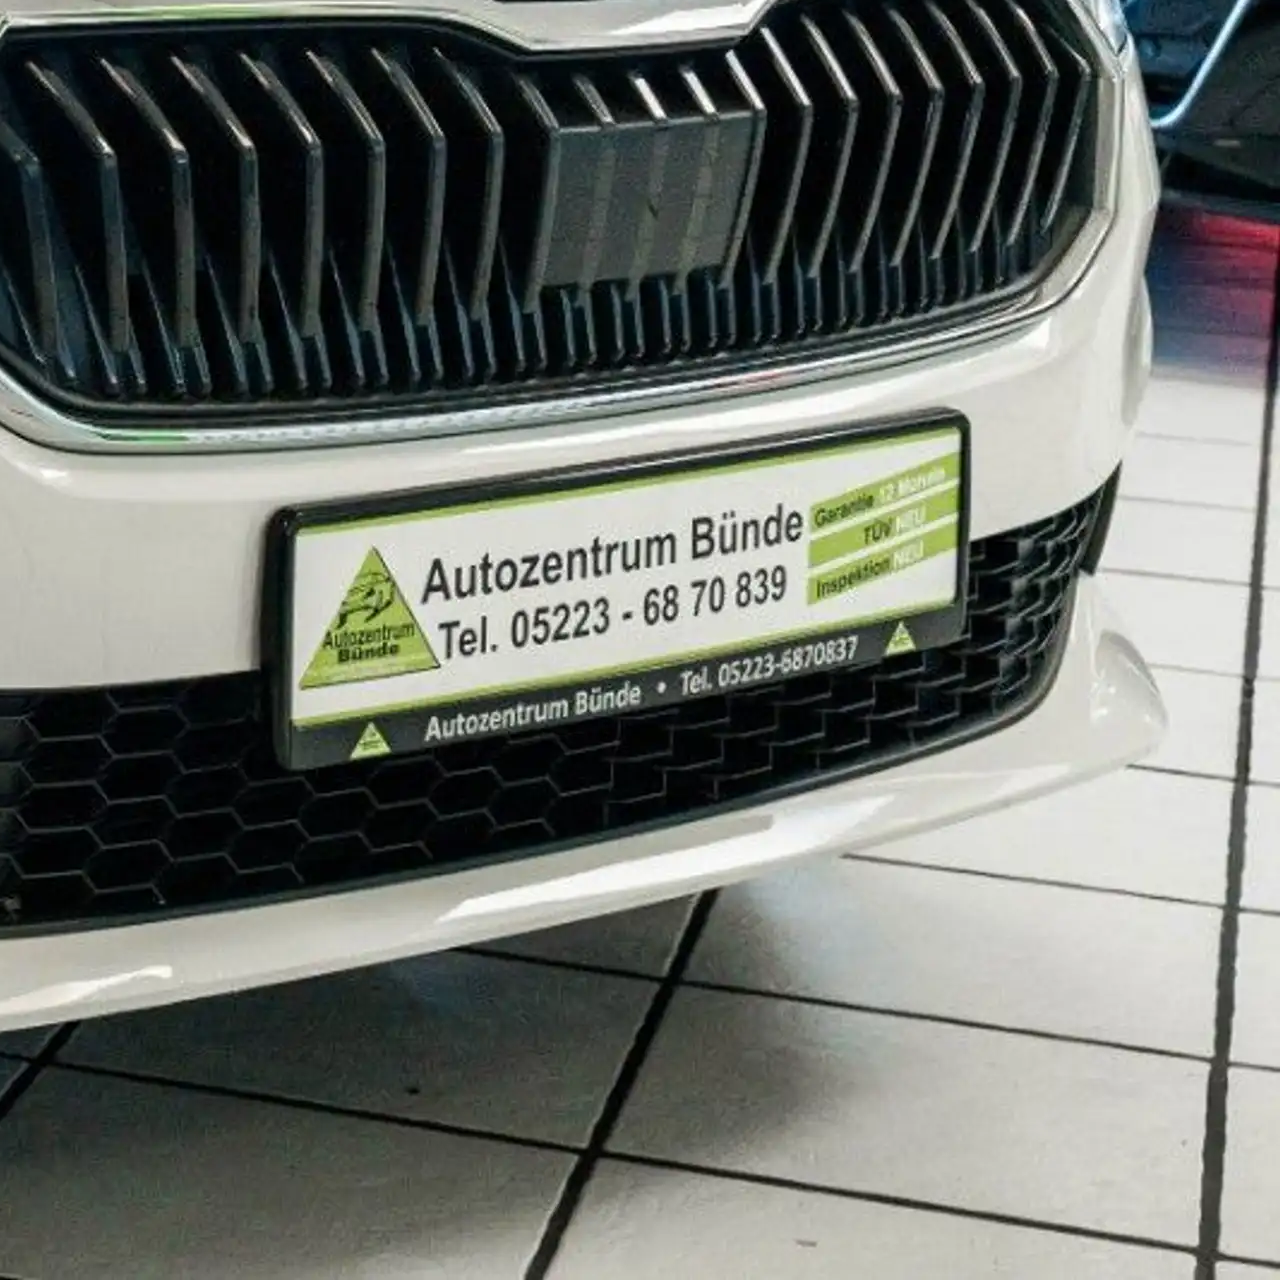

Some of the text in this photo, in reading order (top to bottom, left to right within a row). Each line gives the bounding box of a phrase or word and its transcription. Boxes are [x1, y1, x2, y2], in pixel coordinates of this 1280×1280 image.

[420, 503, 803, 605] Autozentrum Bünde
[323, 621, 416, 651] Autozentrum
[337, 643, 401, 664] Bünde
[438, 615, 498, 661] Tel.
[510, 597, 611, 648] 05223
[642, 584, 681, 627] 68
[691, 576, 727, 617] 70
[735, 564, 788, 609] 839
[424, 634, 860, 742] Autozentrum Bünde Tel. 05223-6870837
